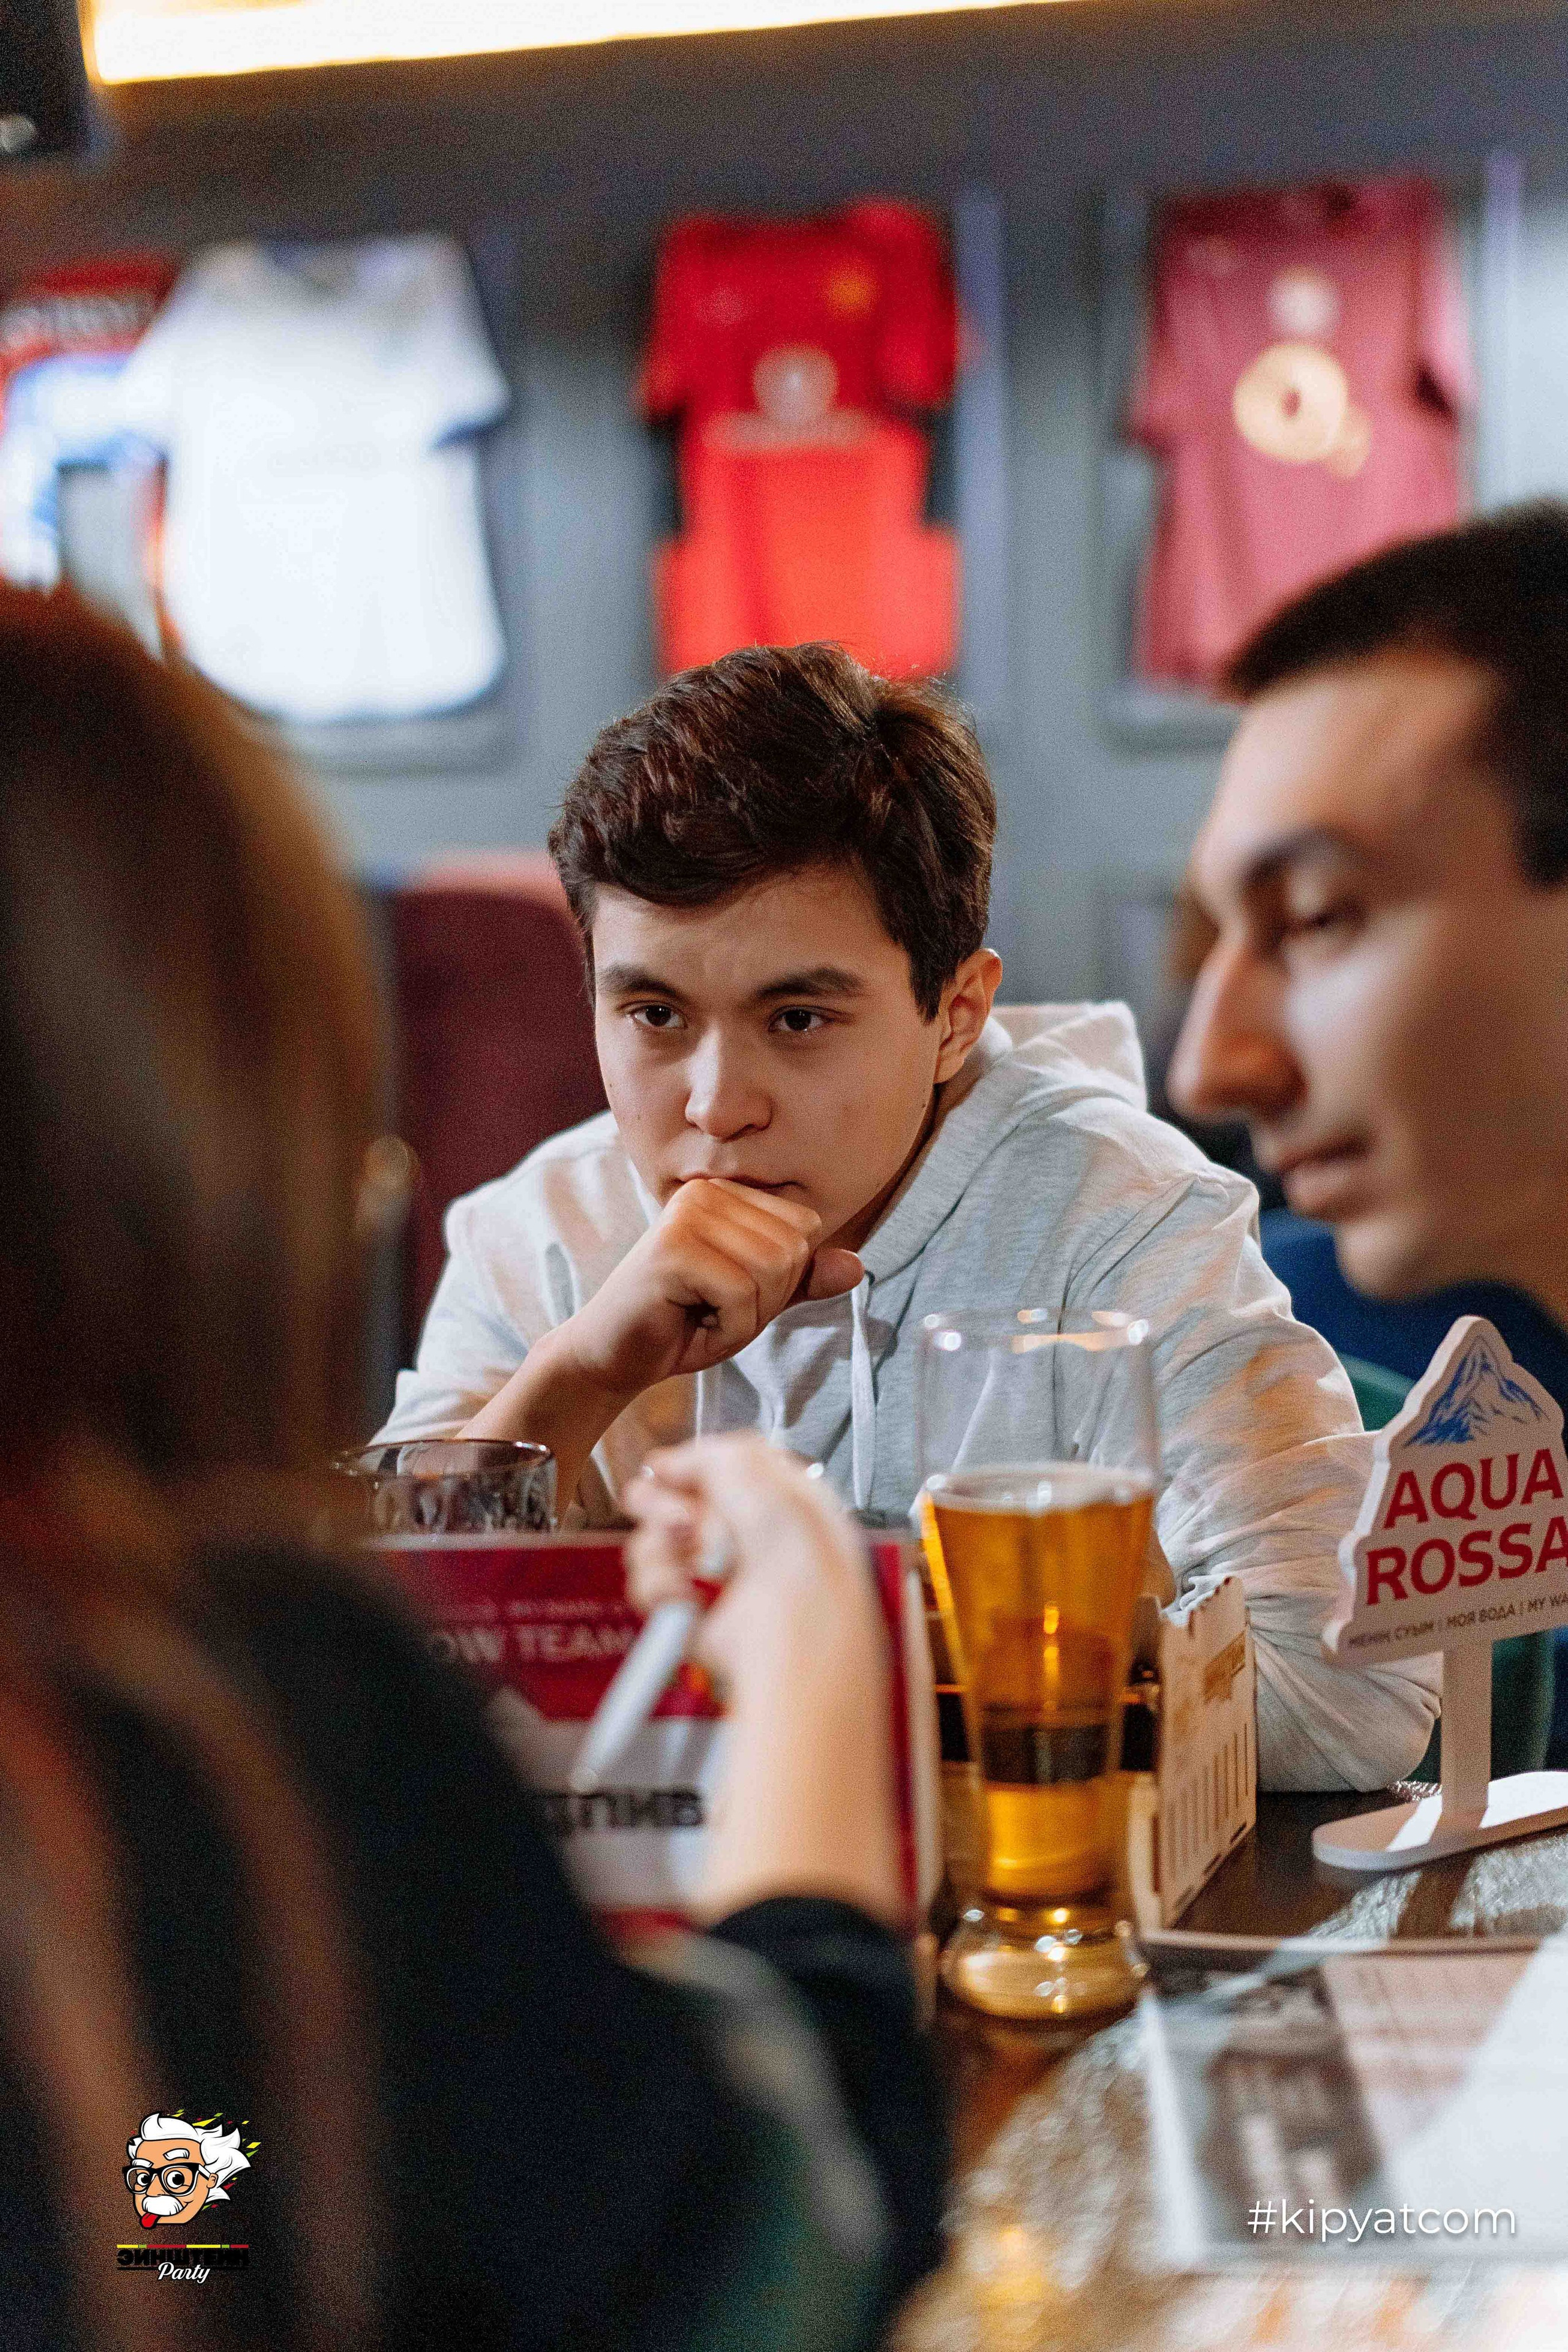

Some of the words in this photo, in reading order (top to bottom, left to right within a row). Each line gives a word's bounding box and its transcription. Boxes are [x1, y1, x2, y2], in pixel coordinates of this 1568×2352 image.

[1382, 1448, 1564, 1529] AQUA
[1366, 1515, 1568, 1605] ROSSA
[1446, 1612, 1476, 1629] МОЯ
[1479, 1603, 1515, 1622] ВОДА
[1527, 1597, 1547, 1613] MY
